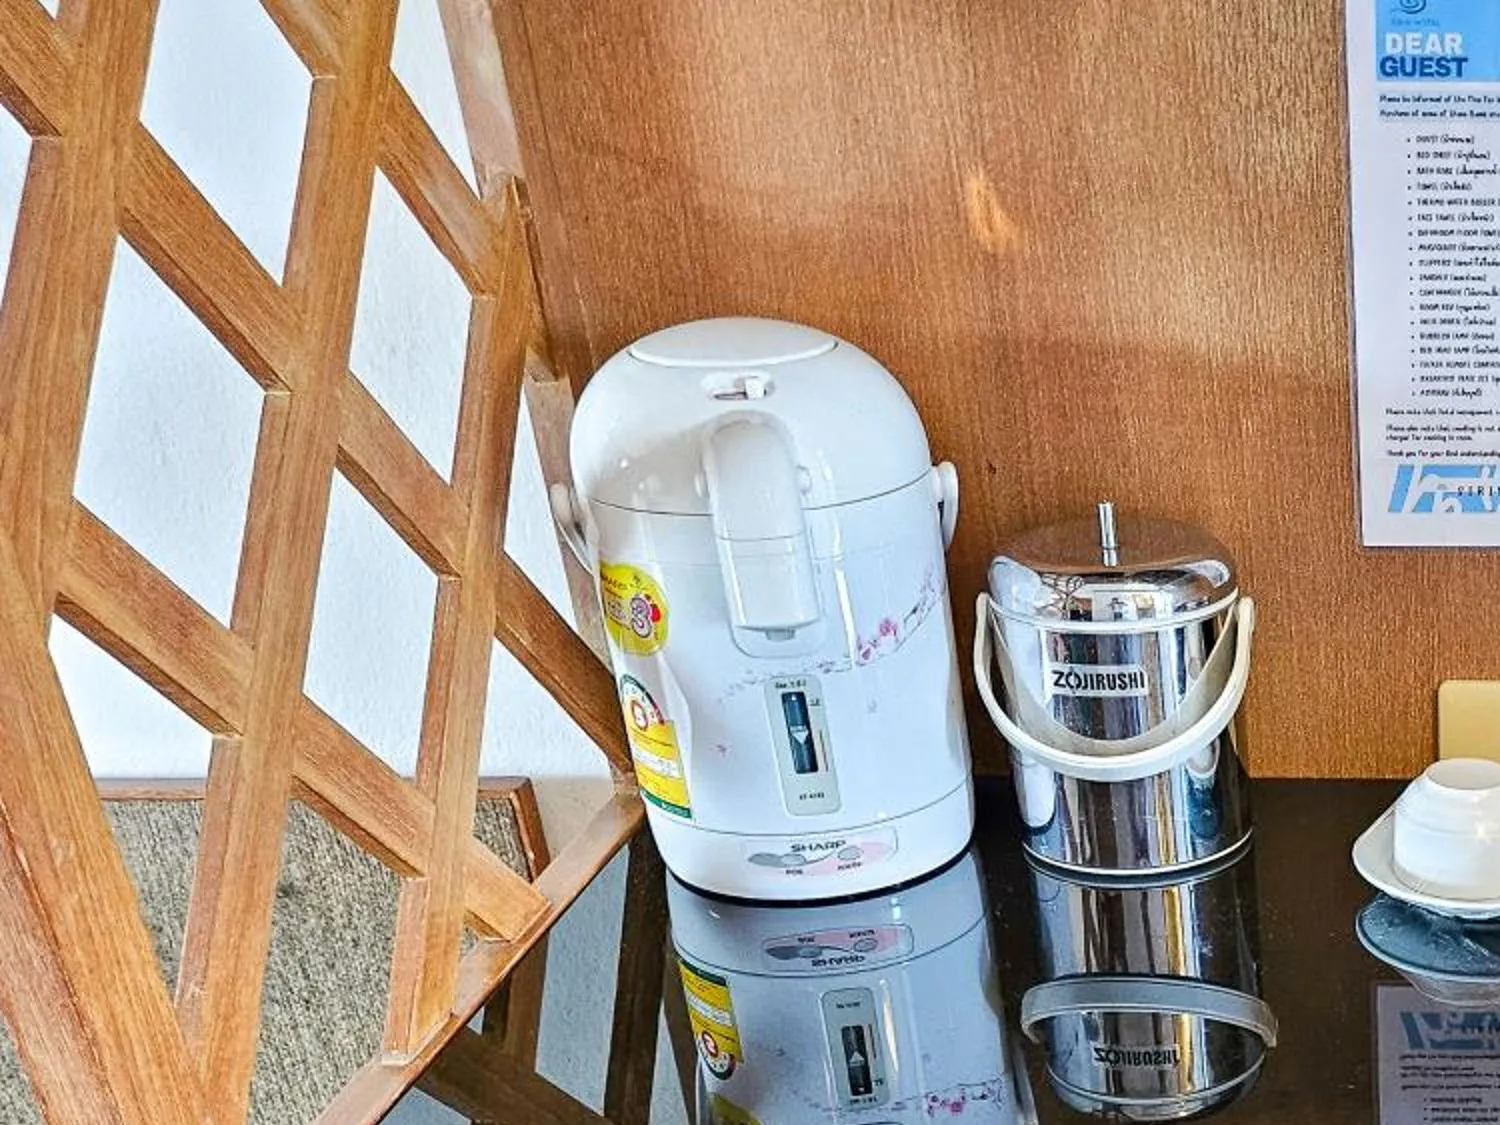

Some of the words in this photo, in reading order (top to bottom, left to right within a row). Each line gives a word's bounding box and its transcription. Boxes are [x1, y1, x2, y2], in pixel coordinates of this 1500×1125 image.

[1385, 31, 1464, 55] DEAR
[1379, 56, 1468, 78] GUEST
[1052, 669, 1145, 690] ZOJIRUSHI
[791, 840, 846, 852] SHARP
